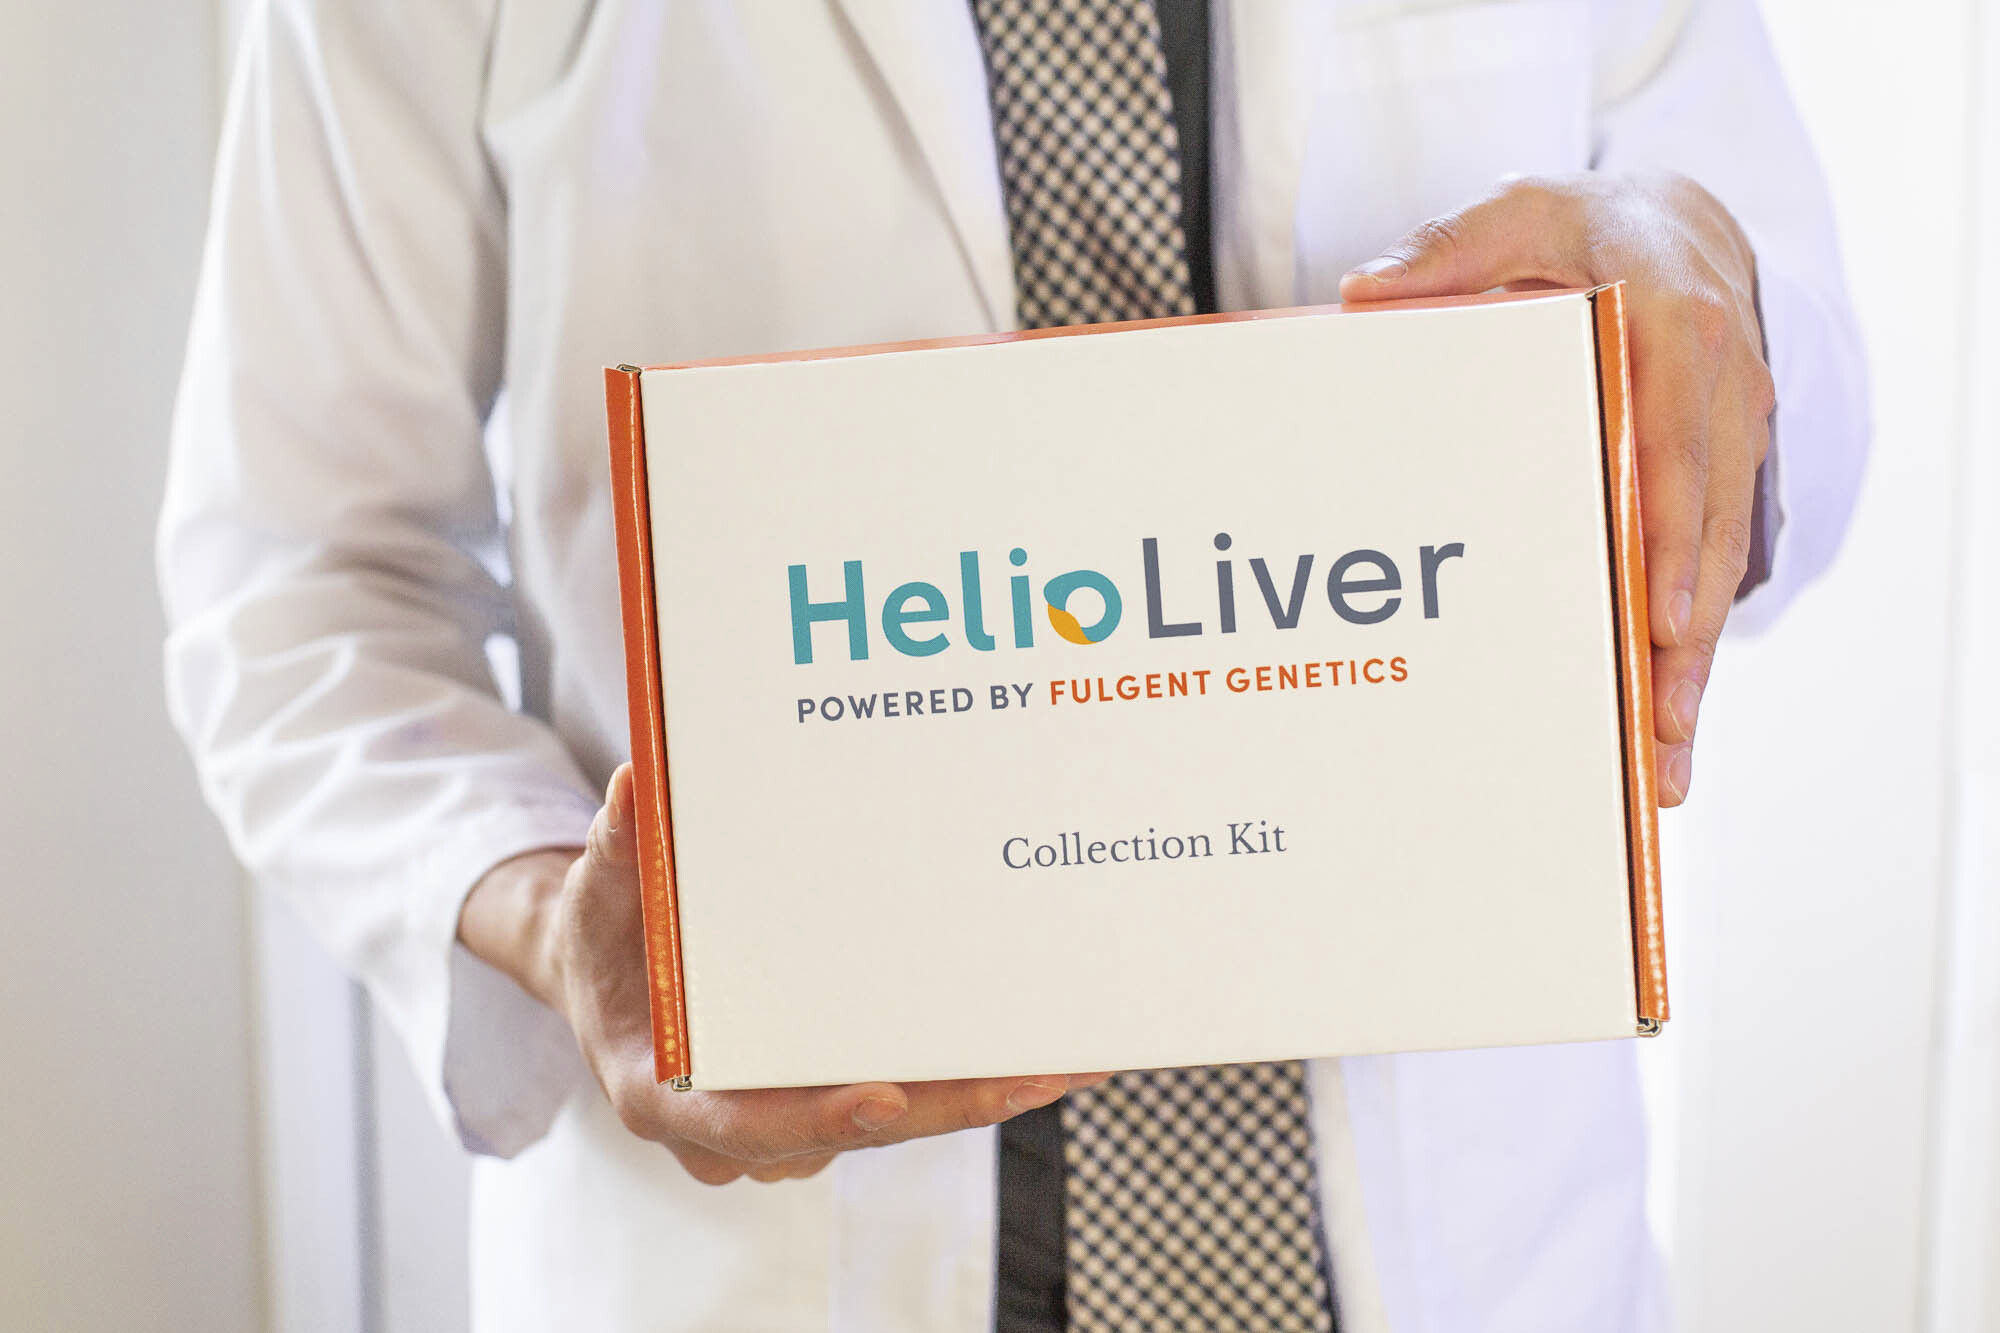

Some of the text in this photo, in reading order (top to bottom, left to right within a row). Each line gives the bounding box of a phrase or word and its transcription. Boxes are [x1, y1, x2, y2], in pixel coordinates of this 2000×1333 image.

[797, 655, 1409, 724] POWERED BY FULGENT GENETICS
[1002, 821, 1288, 869] Collection Kit
